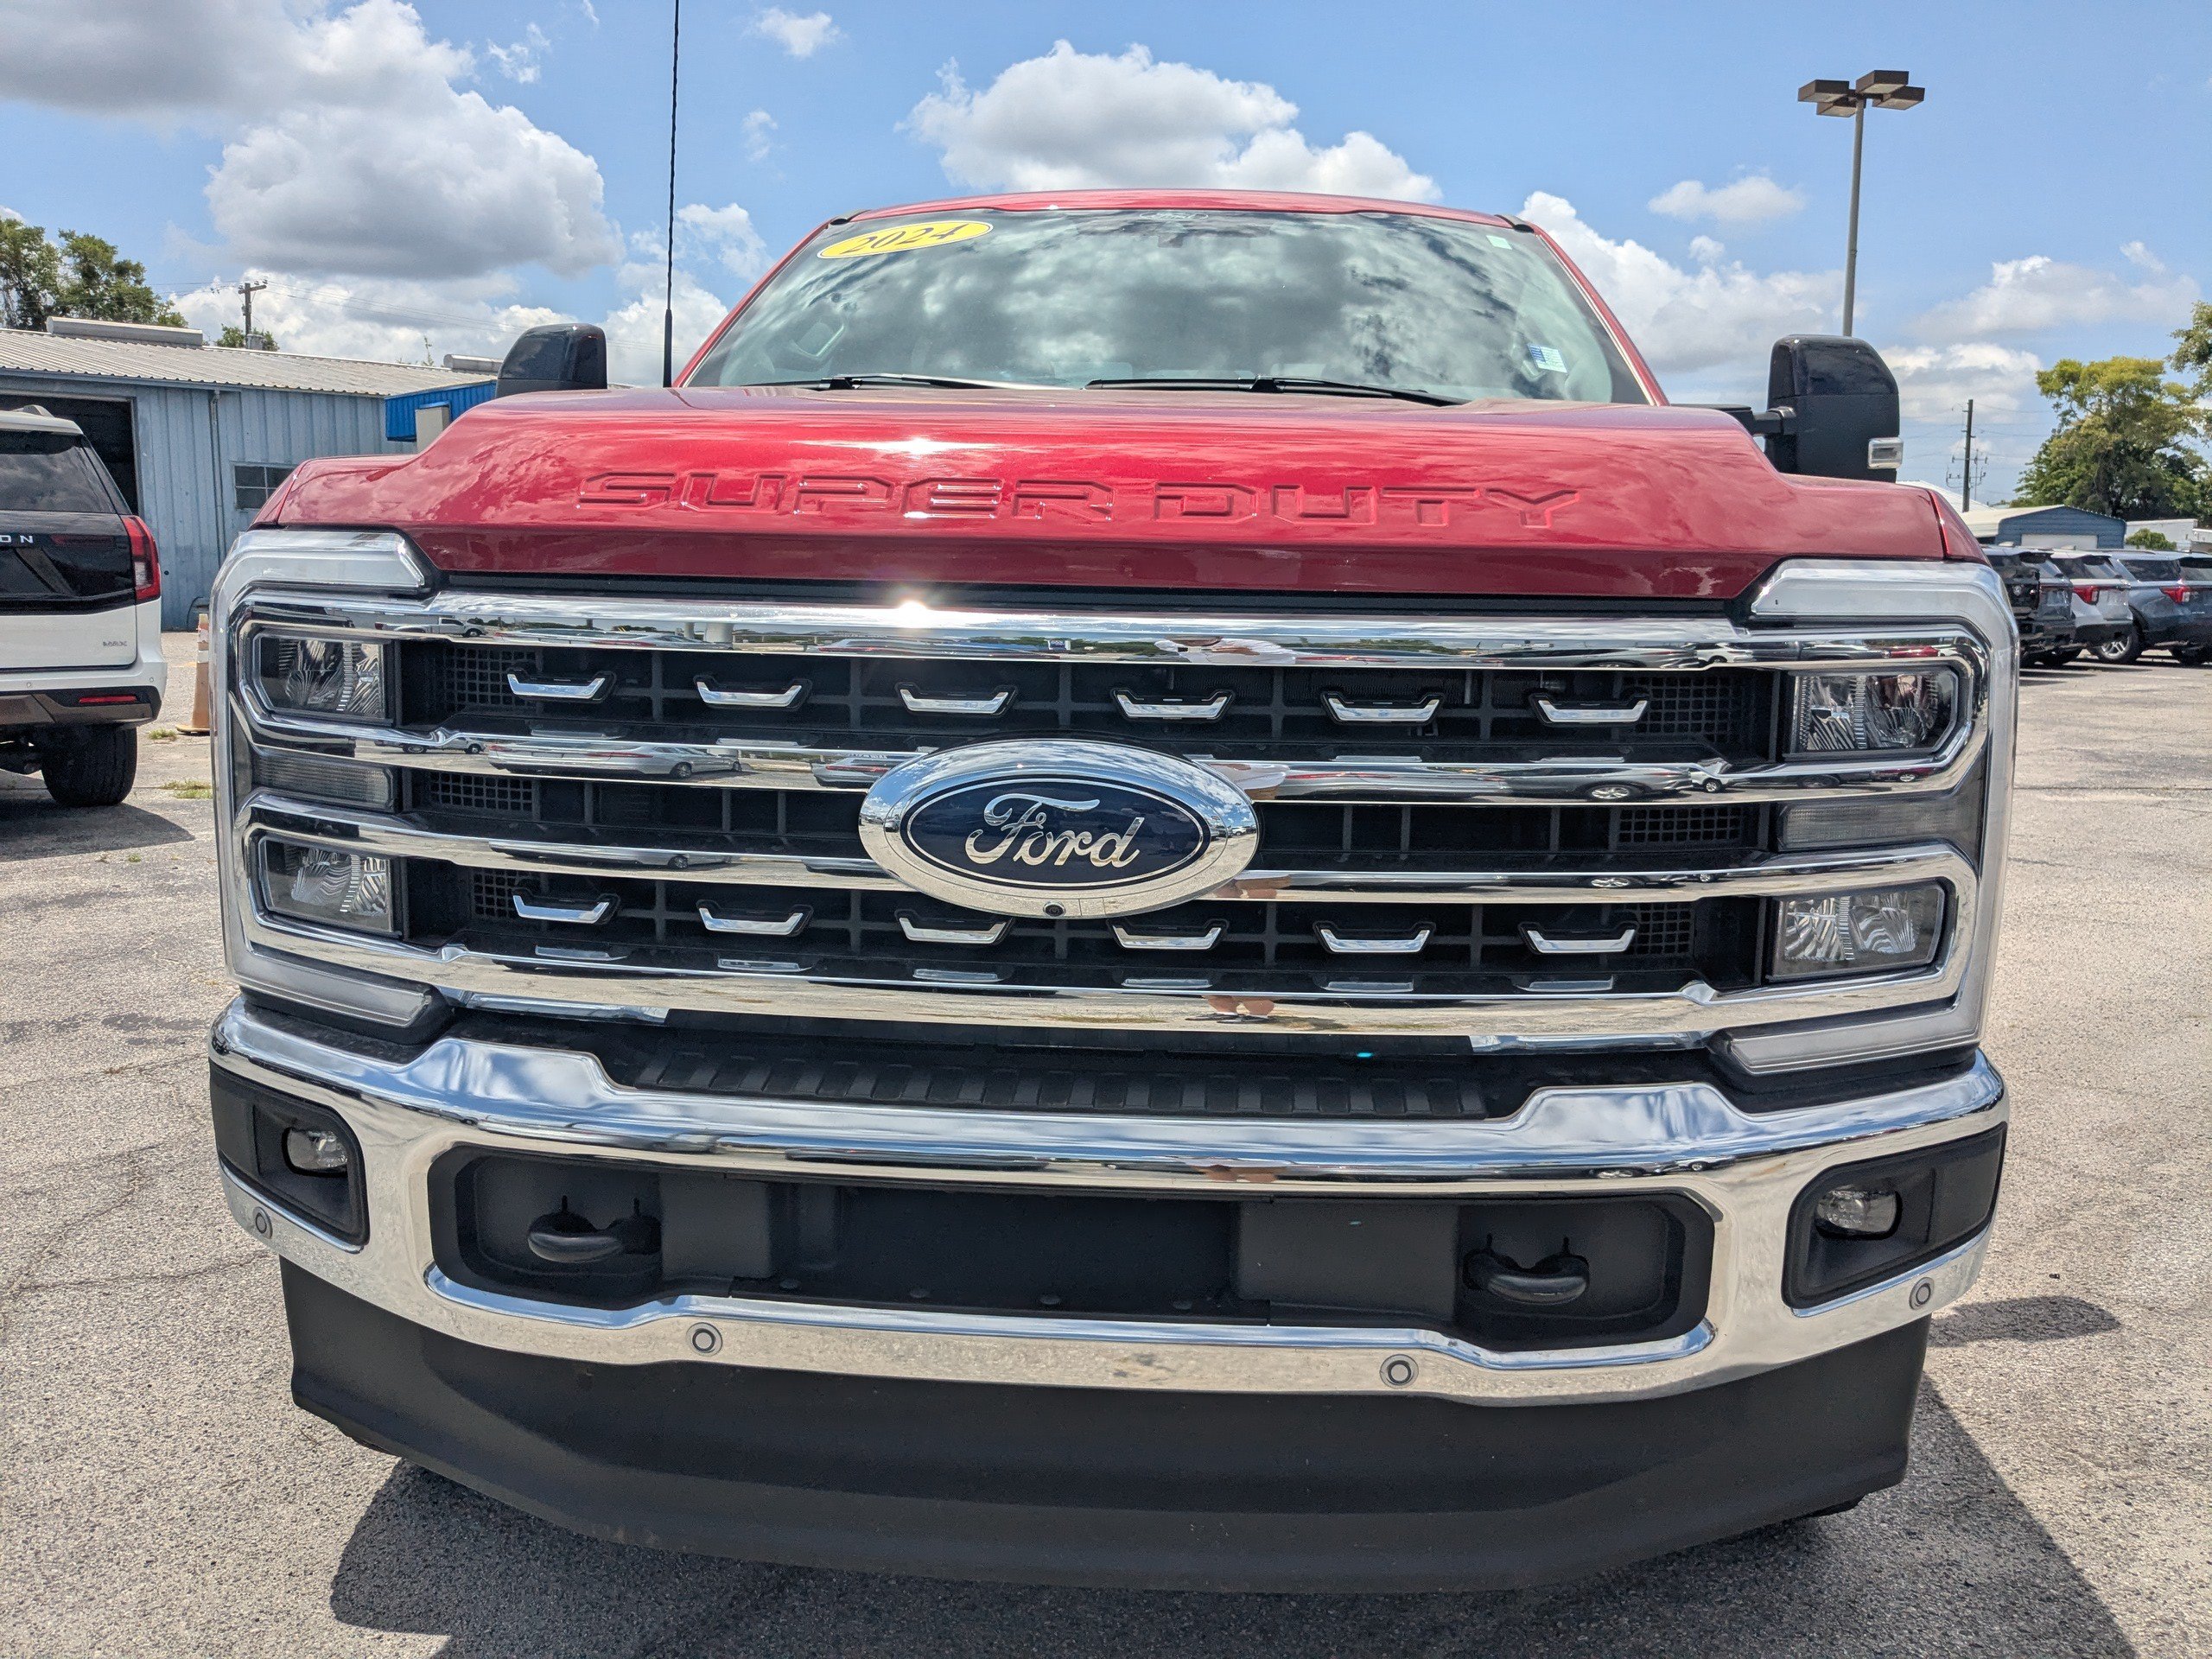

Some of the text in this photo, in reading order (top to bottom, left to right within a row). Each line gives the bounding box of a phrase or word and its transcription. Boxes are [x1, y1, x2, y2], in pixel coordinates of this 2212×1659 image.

[841, 223, 969, 255] 2024
[575, 472, 1580, 529] SUPER DUTY
[964, 792, 1146, 868] Ford
